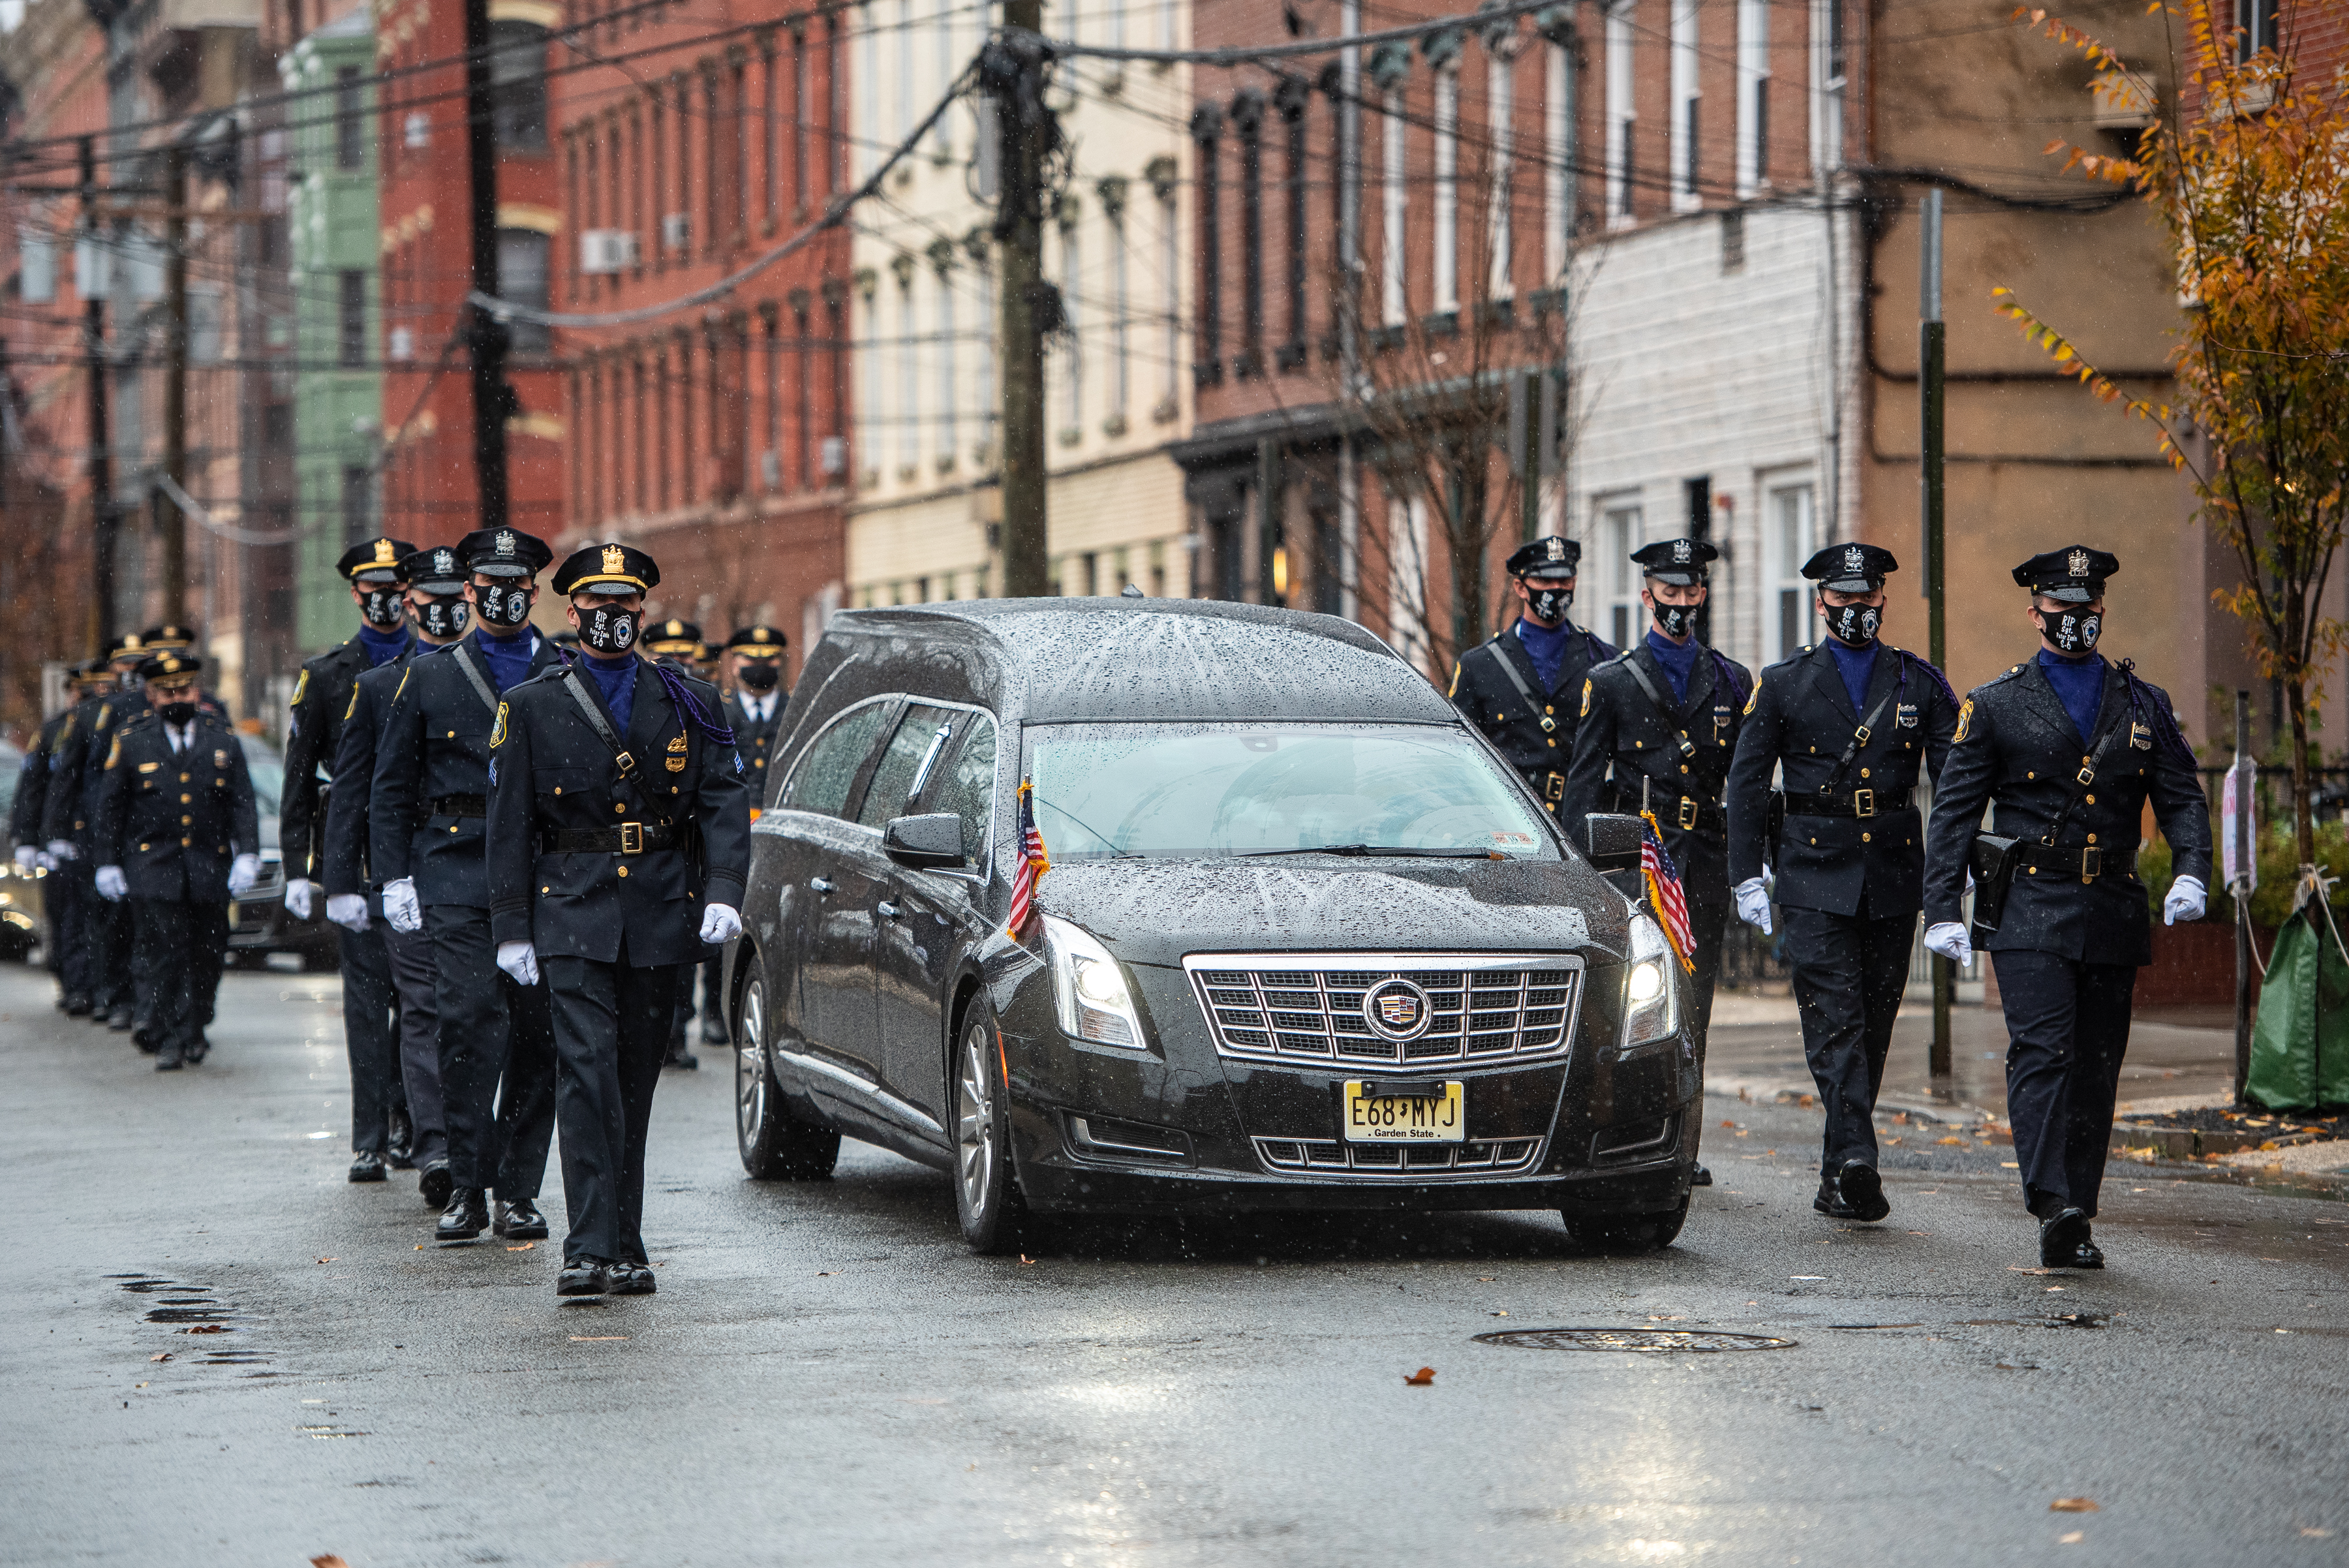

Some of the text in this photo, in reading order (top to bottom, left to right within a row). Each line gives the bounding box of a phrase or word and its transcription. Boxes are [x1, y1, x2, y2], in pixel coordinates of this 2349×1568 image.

[489, 586, 502, 598] RIP
[430, 604, 442, 615] RIP
[485, 608, 496, 619] S-6
[1843, 607, 1854, 620] RIP
[595, 609, 607, 623] RIP
[1841, 617, 1852, 626] Sgt.
[2062, 615, 2076, 626] RIP
[594, 621, 606, 630] Sgt.
[2061, 626, 2073, 634] Sgt.
[590, 628, 600, 636] Peter
[1840, 629, 1850, 639] S-6
[592, 636, 603, 647] S-6
[2061, 639, 2071, 650] S-6
[1353, 1096, 1455, 1126] E68 MYJ
[1374, 1129, 1434, 1138] Garden State
